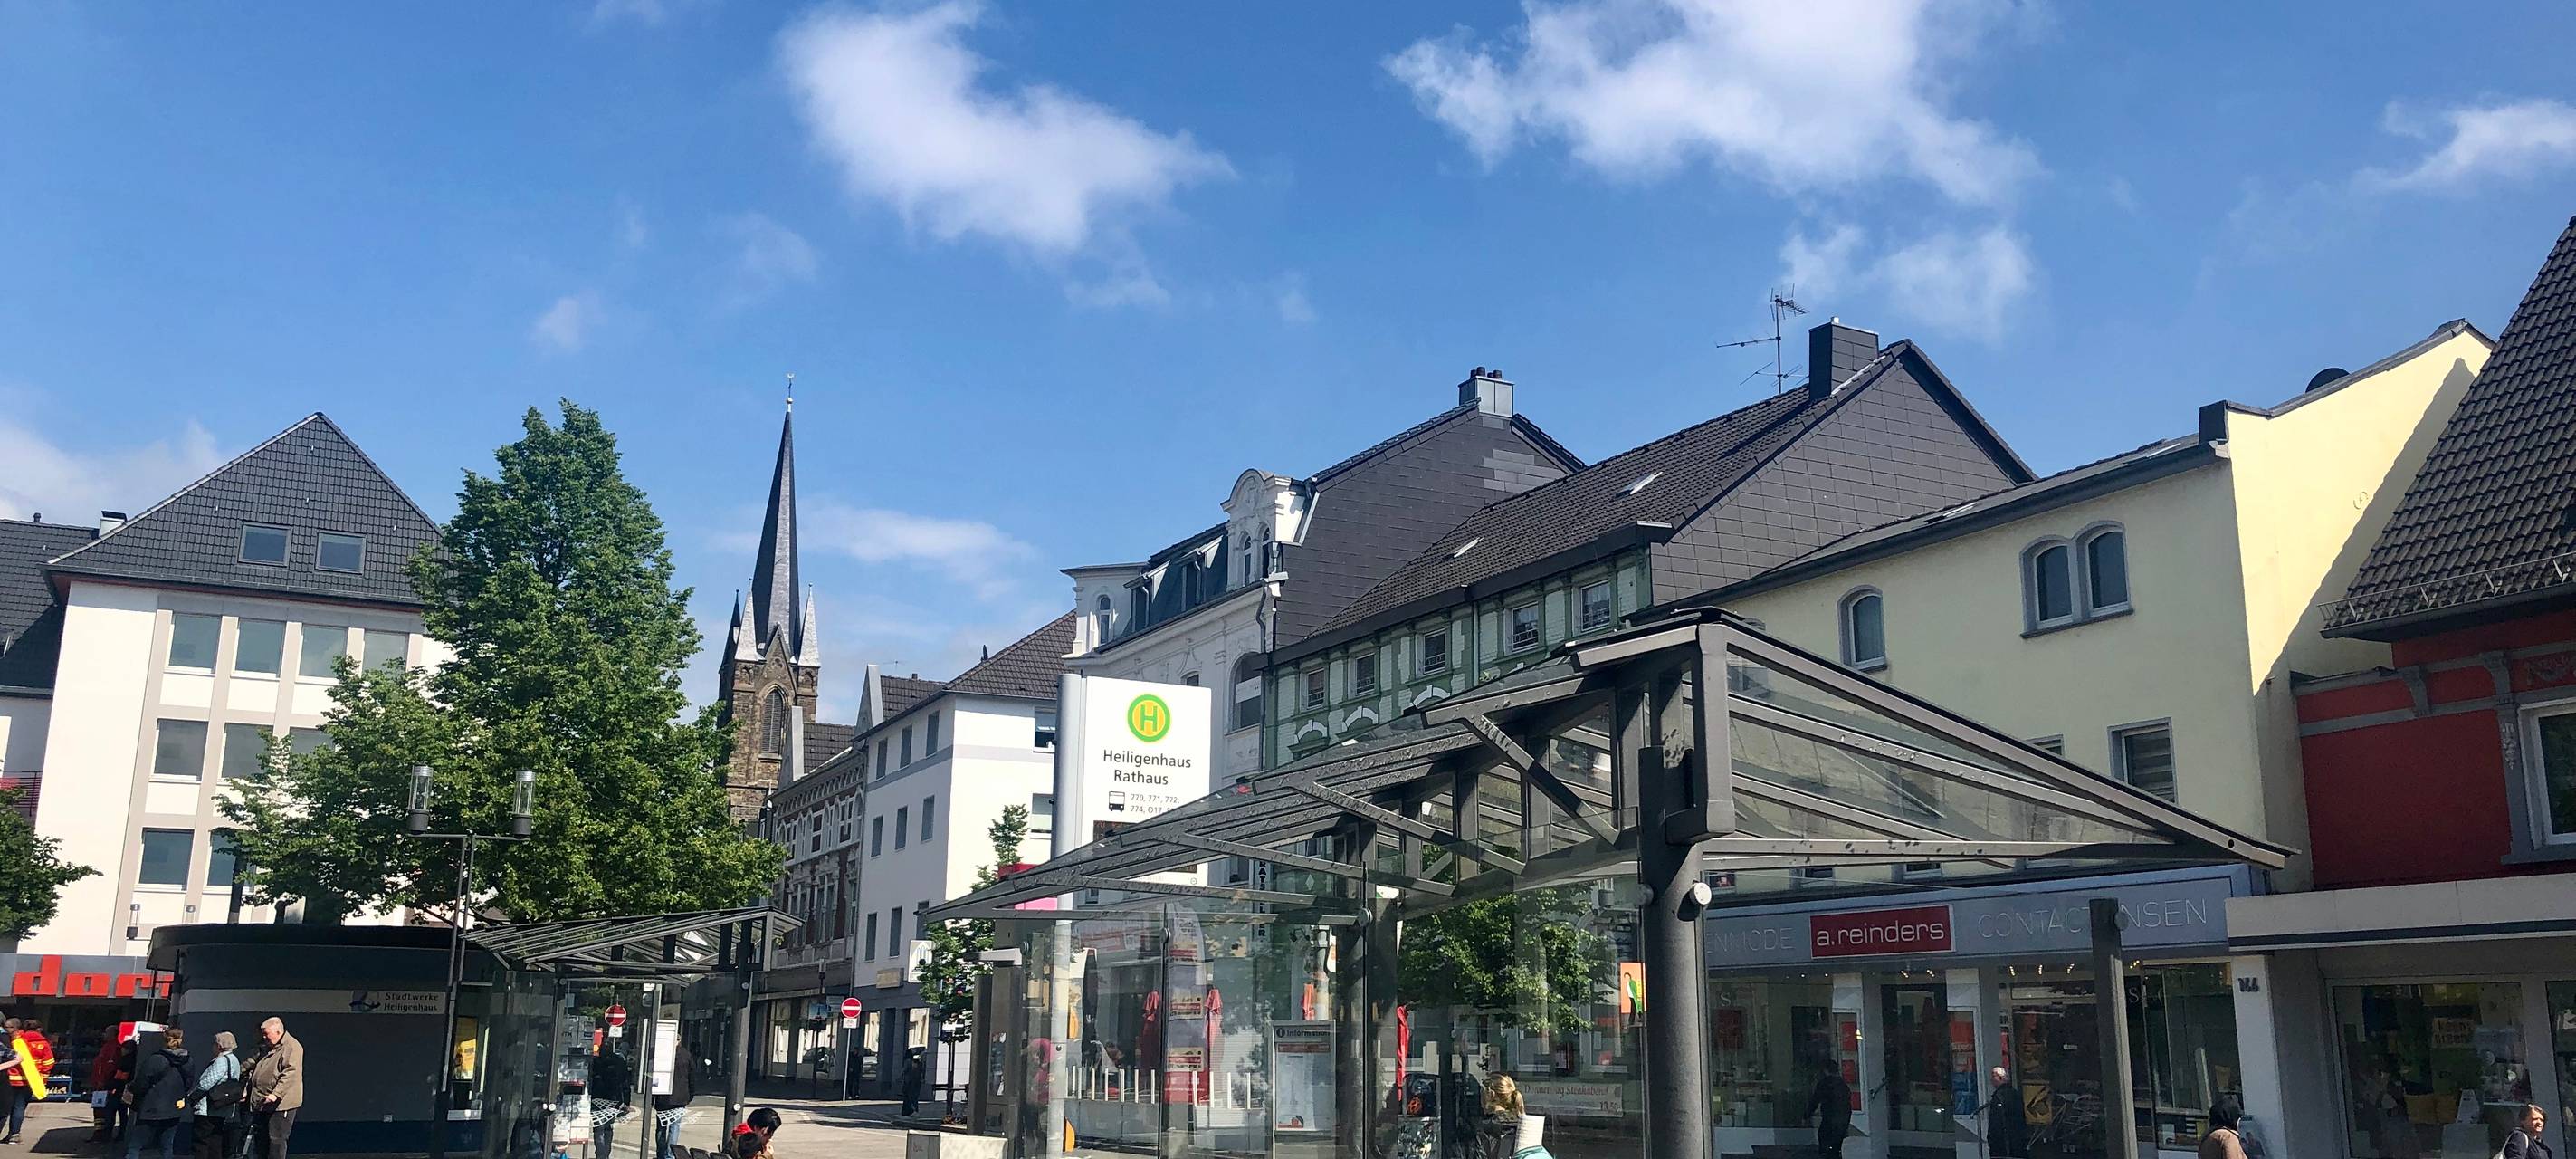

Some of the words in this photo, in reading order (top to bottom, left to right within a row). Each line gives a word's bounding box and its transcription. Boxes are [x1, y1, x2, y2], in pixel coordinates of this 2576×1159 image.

[1140, 704, 1158, 733] H
[1103, 749, 1191, 768] Heiligenhaus
[1113, 769, 1169, 785] Rathaus
[1131, 793, 1146, 802] 770,
[1816, 920, 1945, 946] a.reinders
[385, 992, 439, 1001] Stadtwerke
[383, 1003, 438, 1012] Heiligenhaus
[1286, 1028, 1331, 1038] Information
